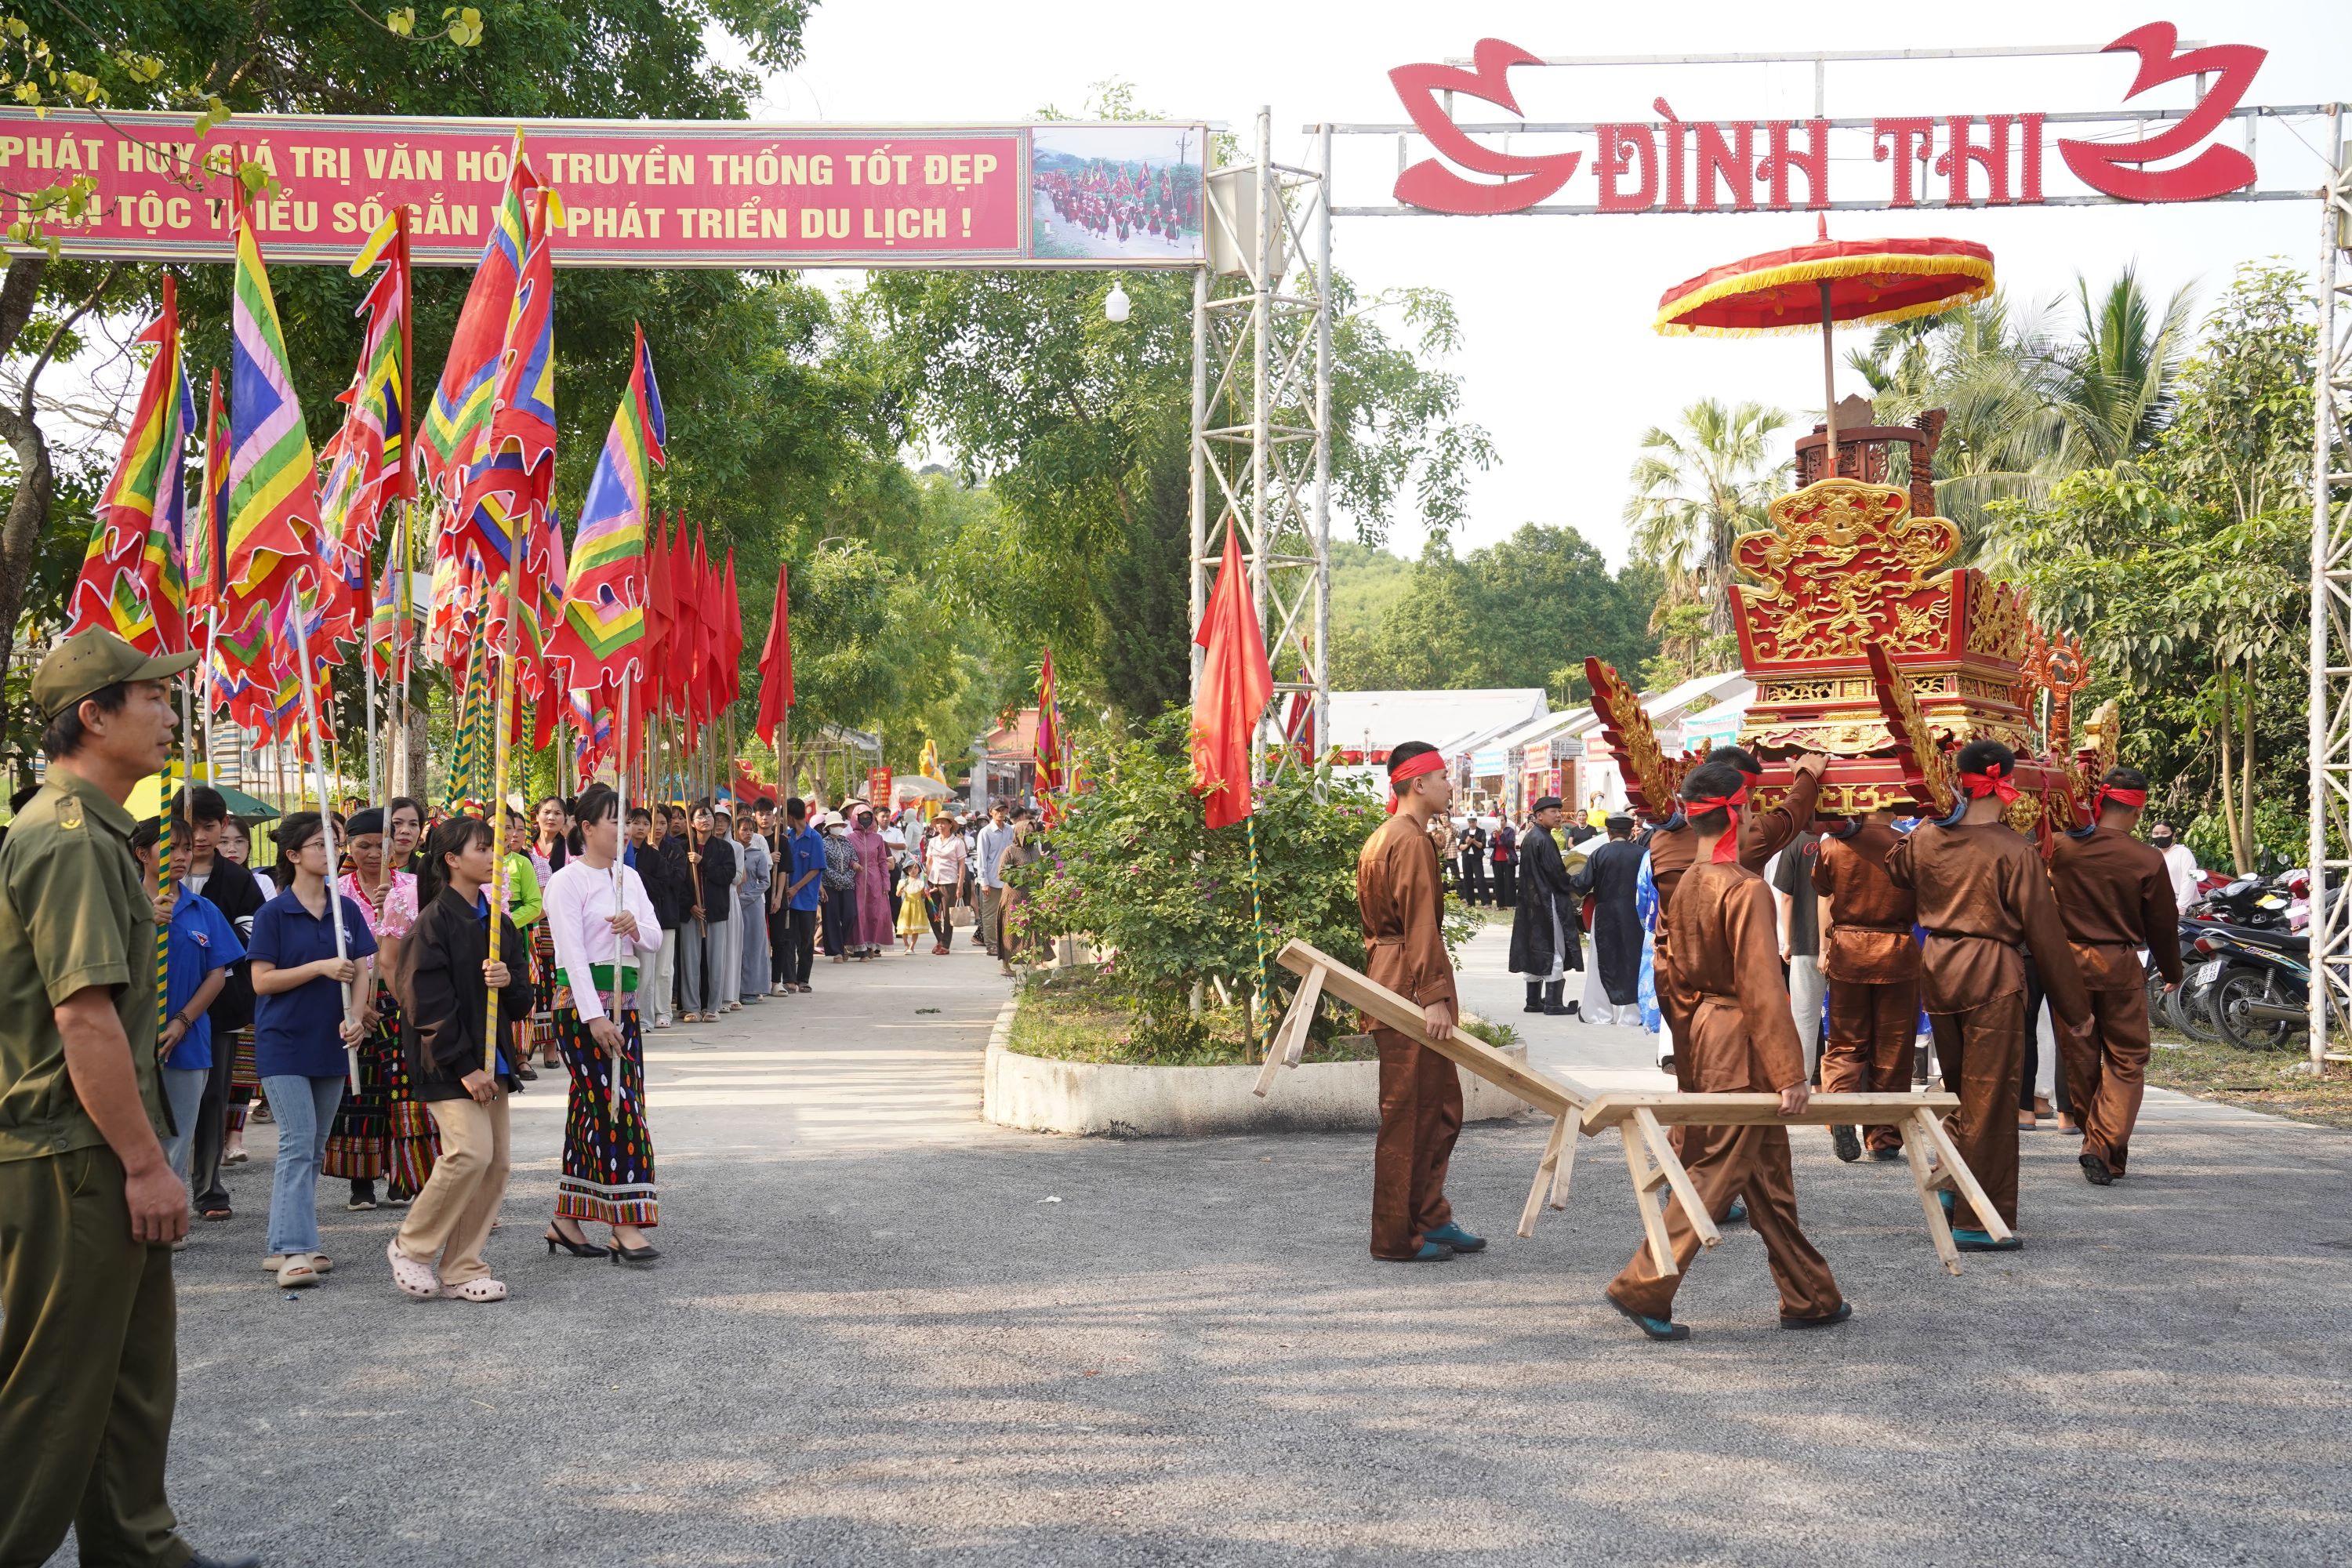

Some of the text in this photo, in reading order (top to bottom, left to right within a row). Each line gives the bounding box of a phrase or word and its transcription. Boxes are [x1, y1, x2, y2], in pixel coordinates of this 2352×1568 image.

[0, 132, 103, 170] PHÁT
[118, 140, 196, 173] HUY
[289, 146, 350, 186] TRỊ
[364, 142, 444, 181] VĂN
[457, 145, 532, 183] HÓ
[546, 144, 695, 185] TRUYỀN
[707, 143, 833, 186] THỐNG
[846, 143, 913, 186] TỐT
[924, 154, 997, 191] ĐẸP
[1592, 96, 2046, 213] ĐÌNH THI
[118, 190, 191, 234] TỘC
[332, 192, 384, 234] SỐ
[567, 201, 665, 238] PHÁT
[677, 195, 787, 239] TRIỂN
[800, 208, 850, 239] DU
[864, 208, 946, 245] LỊCH
